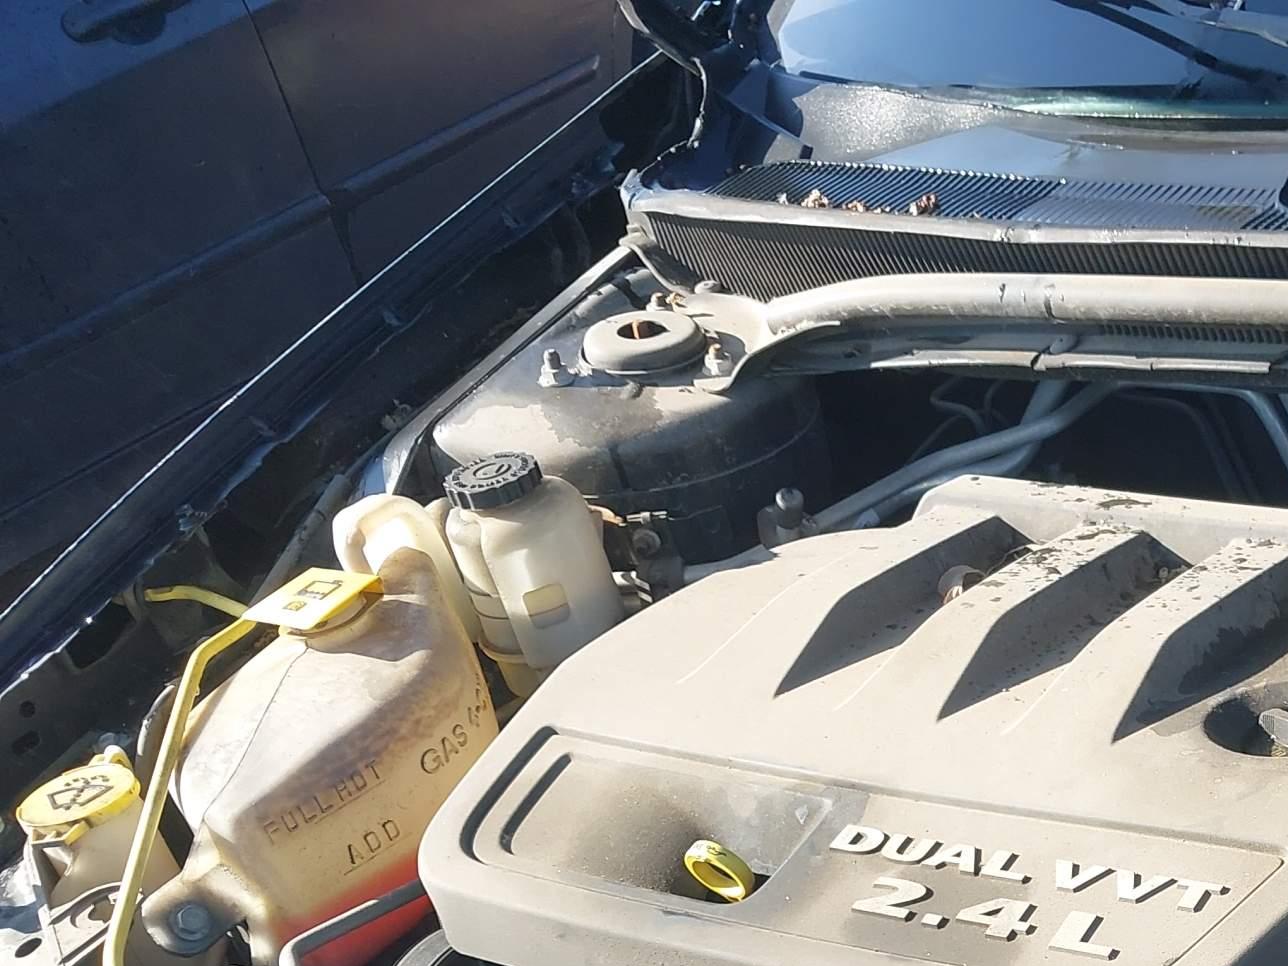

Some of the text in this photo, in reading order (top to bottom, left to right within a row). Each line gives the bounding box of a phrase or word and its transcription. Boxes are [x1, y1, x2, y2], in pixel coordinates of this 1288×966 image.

[347, 819, 400, 865] ADD
[829, 823, 1231, 913] DUAL VVT
[851, 876, 1121, 961] 2.4 L
